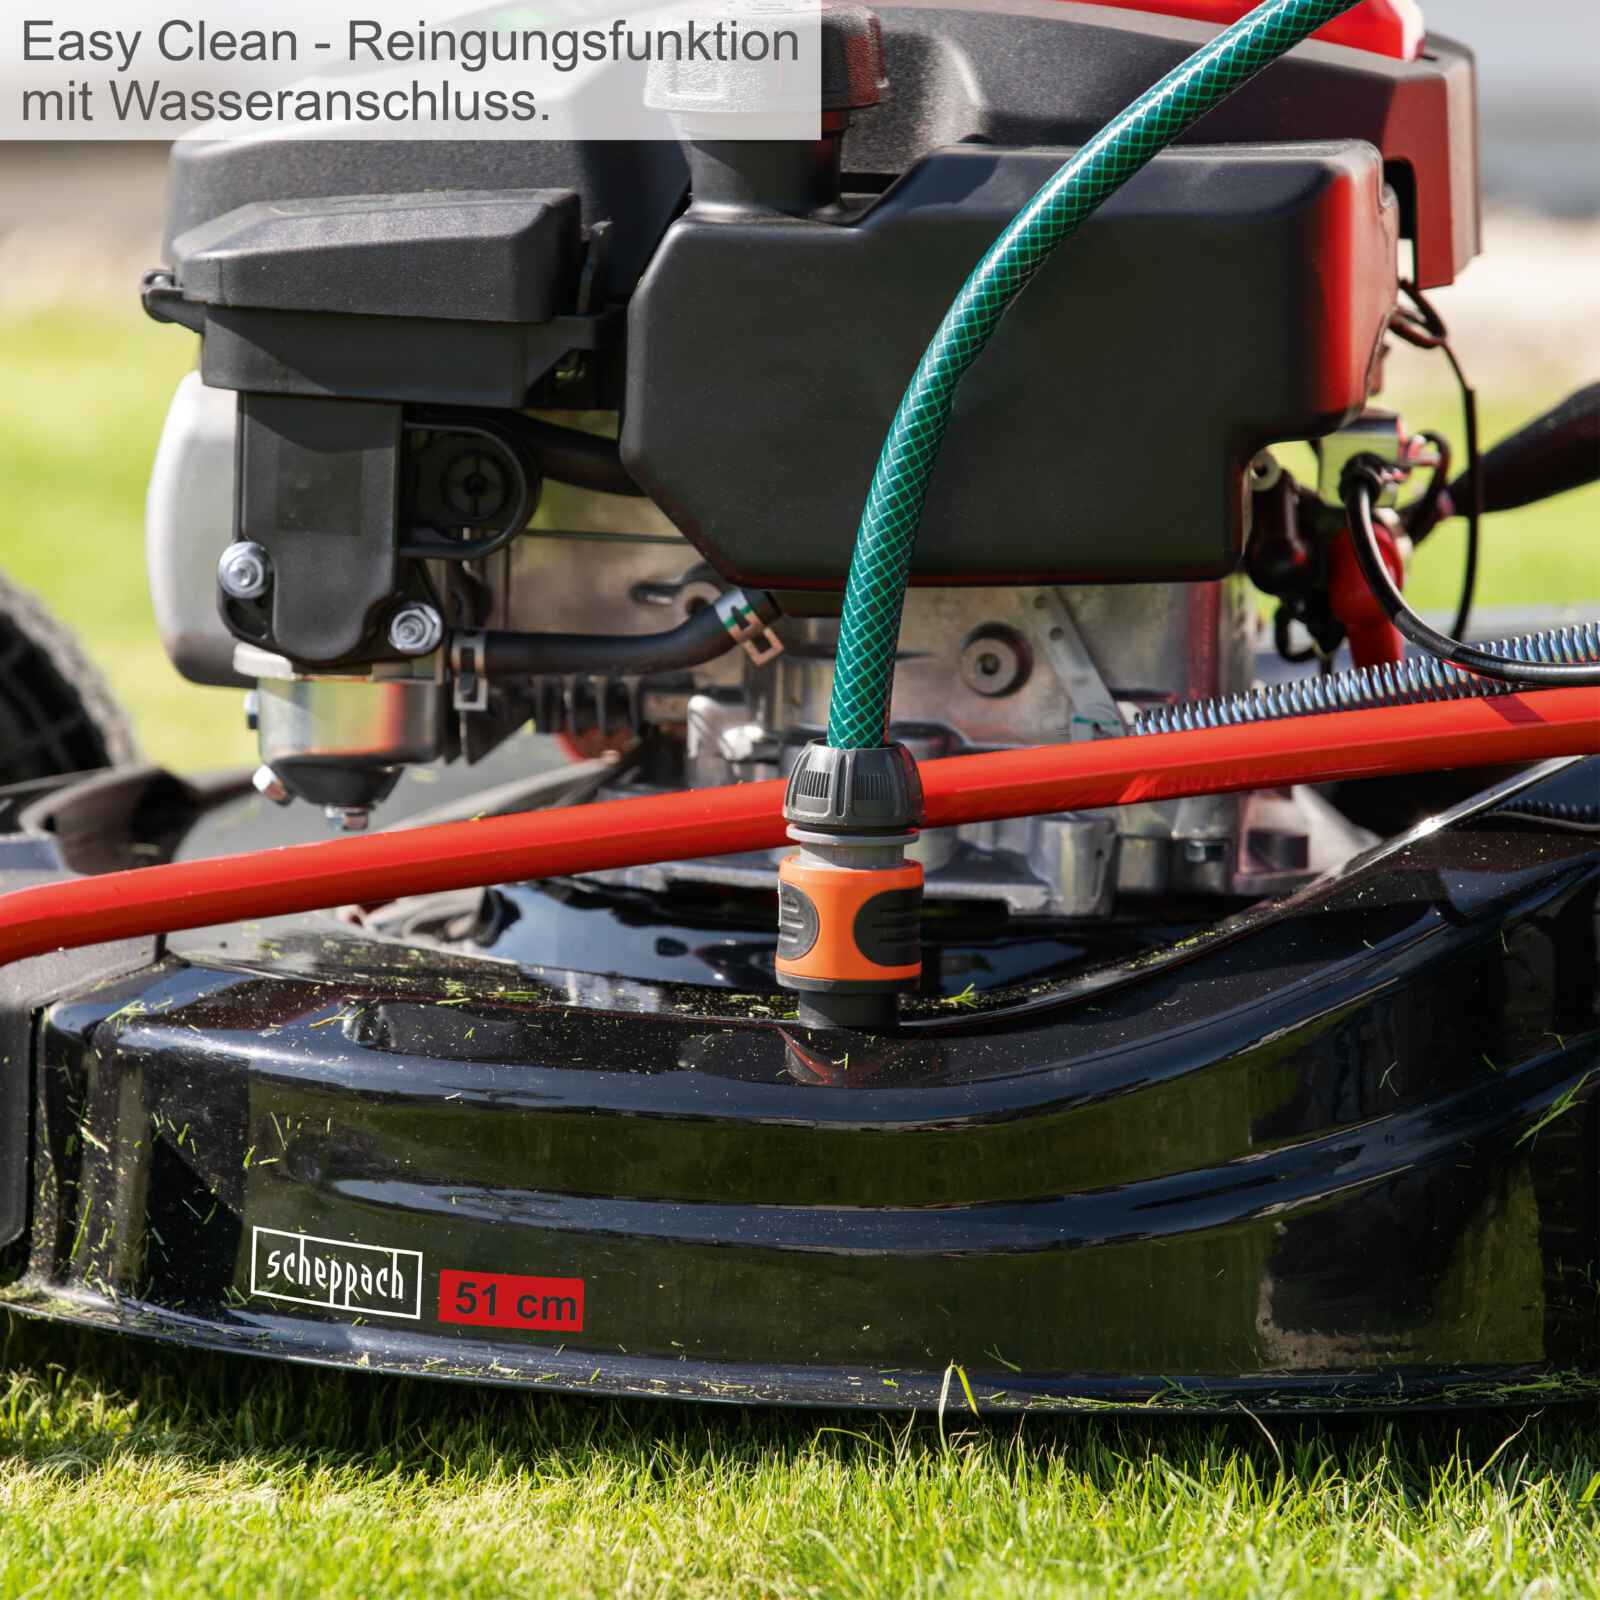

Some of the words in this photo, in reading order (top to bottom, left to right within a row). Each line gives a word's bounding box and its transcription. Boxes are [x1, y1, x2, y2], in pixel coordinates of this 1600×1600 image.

[266, 1235, 404, 1306] scheppach
[455, 1280, 497, 1316] 51
[516, 1294, 577, 1321] cm
